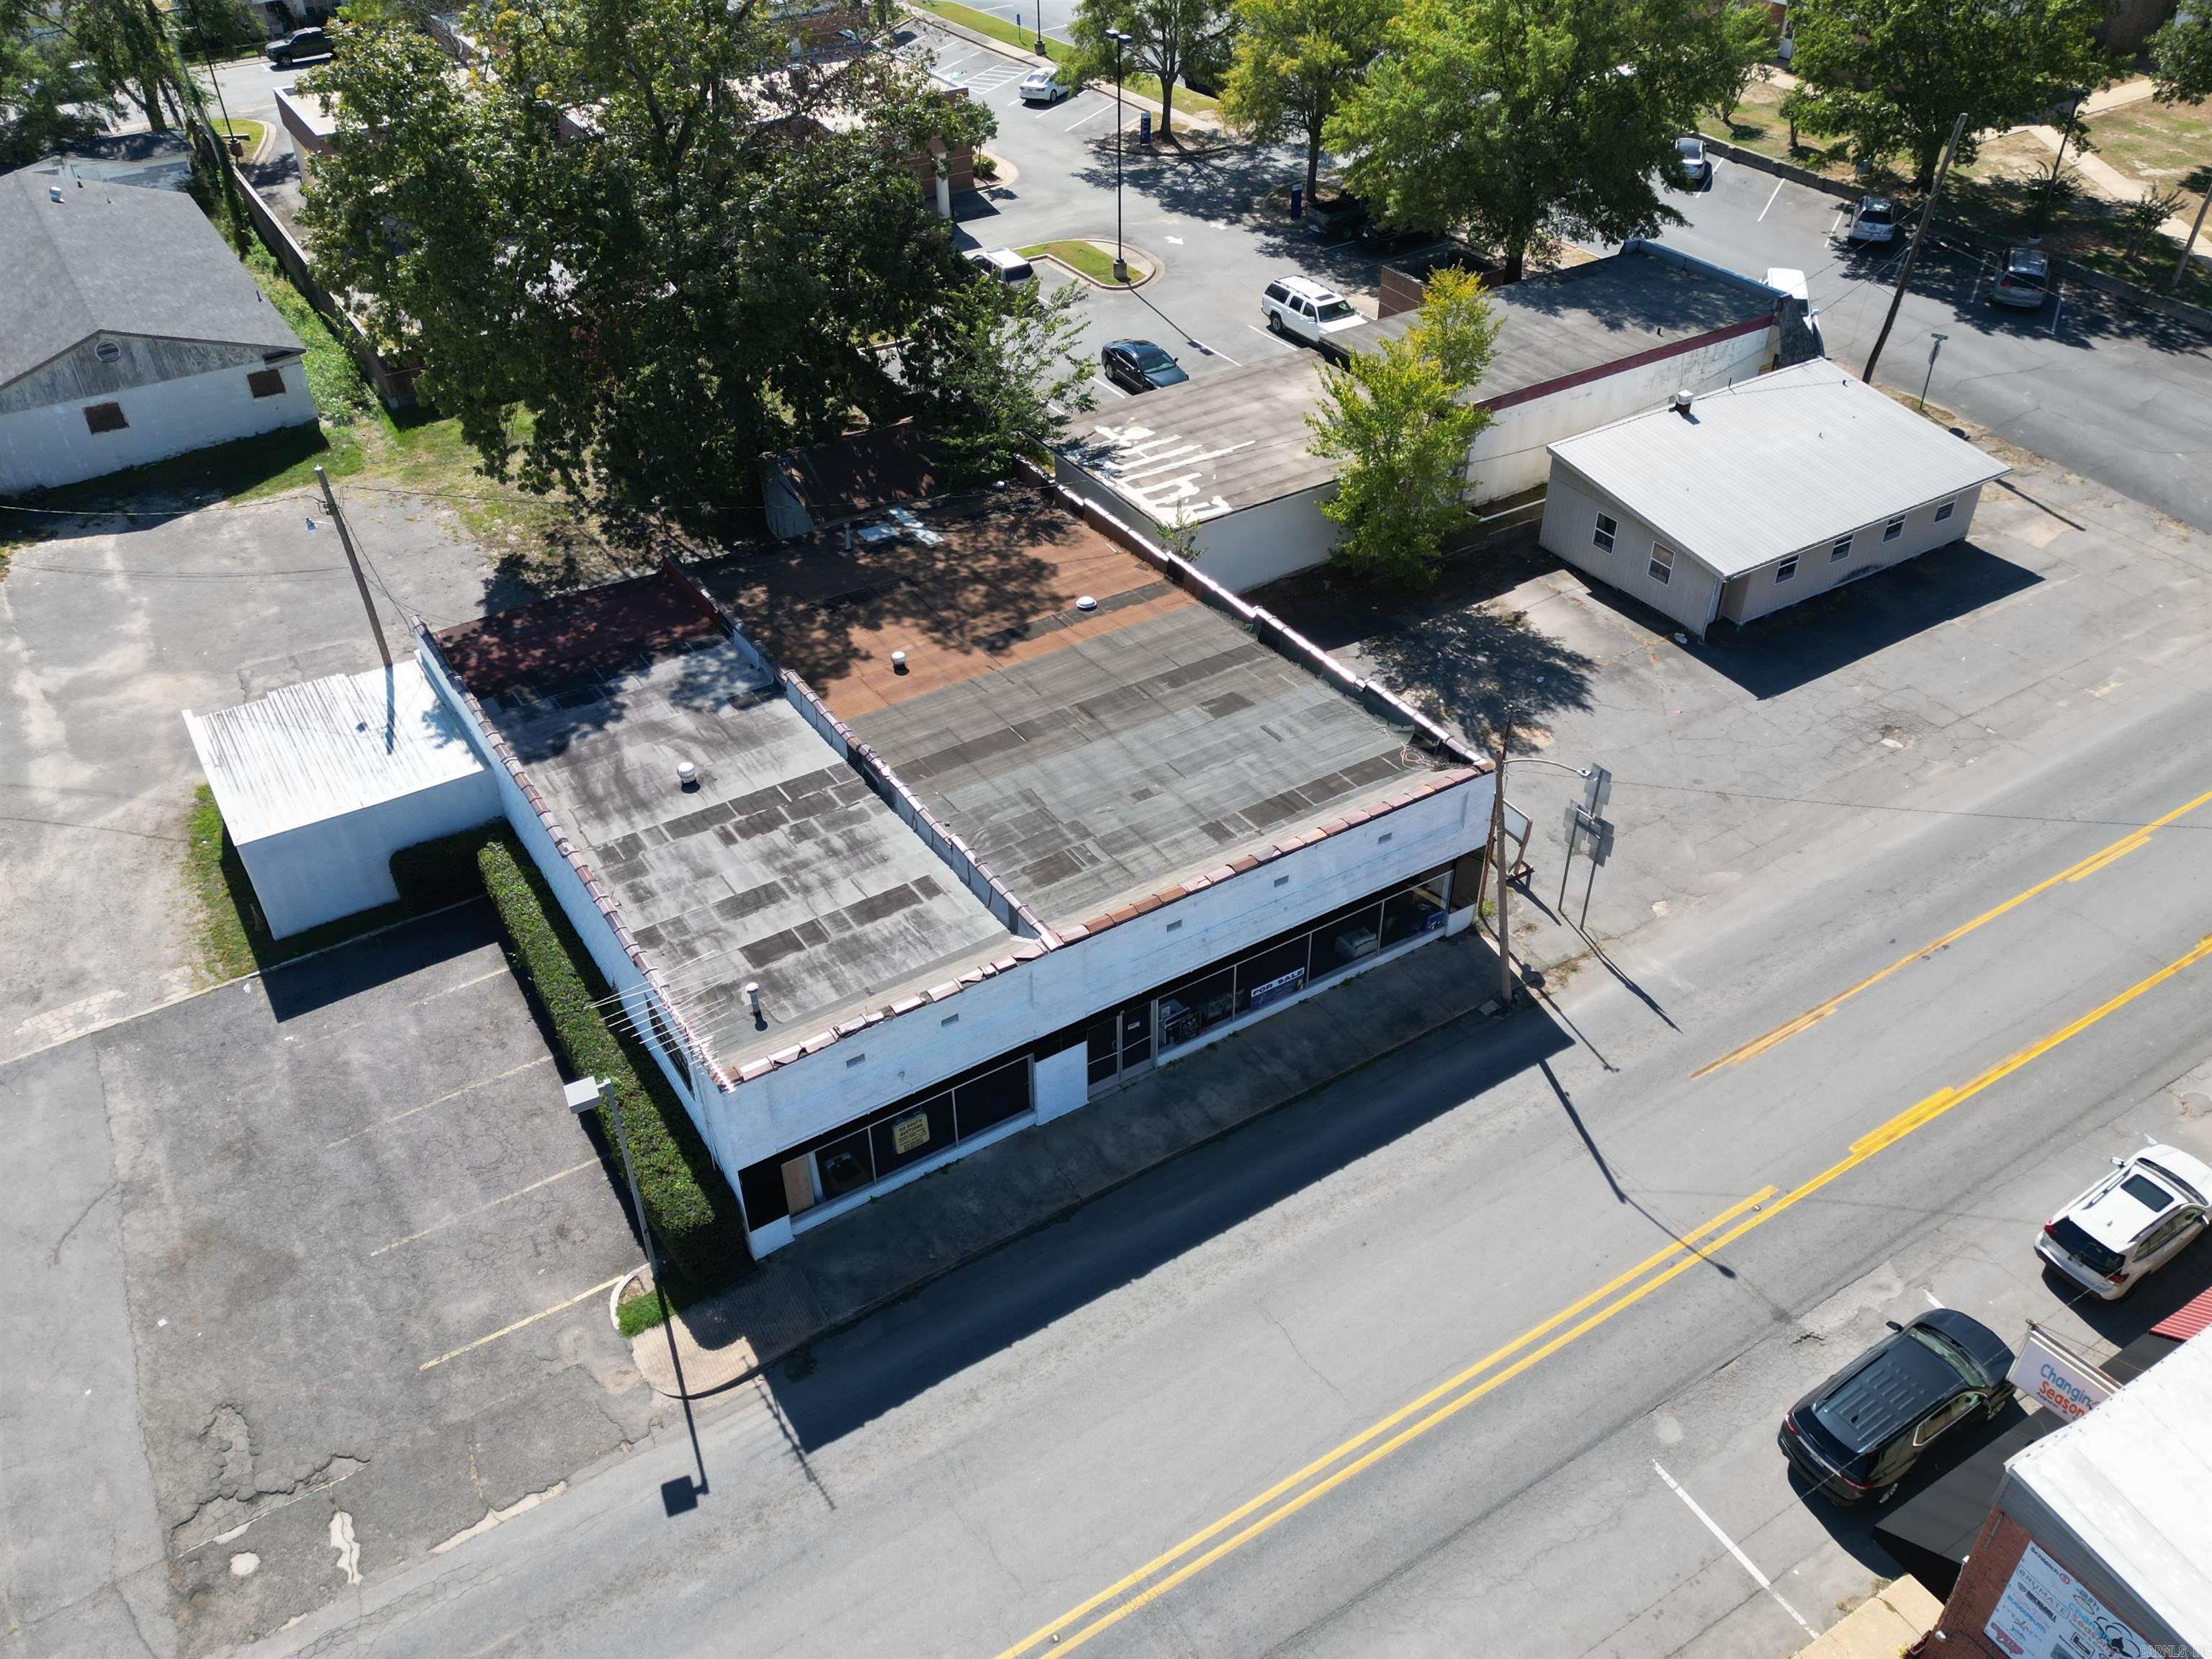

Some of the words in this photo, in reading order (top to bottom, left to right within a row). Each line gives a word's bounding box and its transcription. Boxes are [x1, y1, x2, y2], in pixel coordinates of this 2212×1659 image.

[1253, 984, 1273, 995] FOR
[1278, 969, 1303, 984] SALE
[900, 1123, 923, 1136] AUCTIONS
[2040, 1381, 2086, 1417] Season
[2041, 1363, 2092, 1406] Changin
